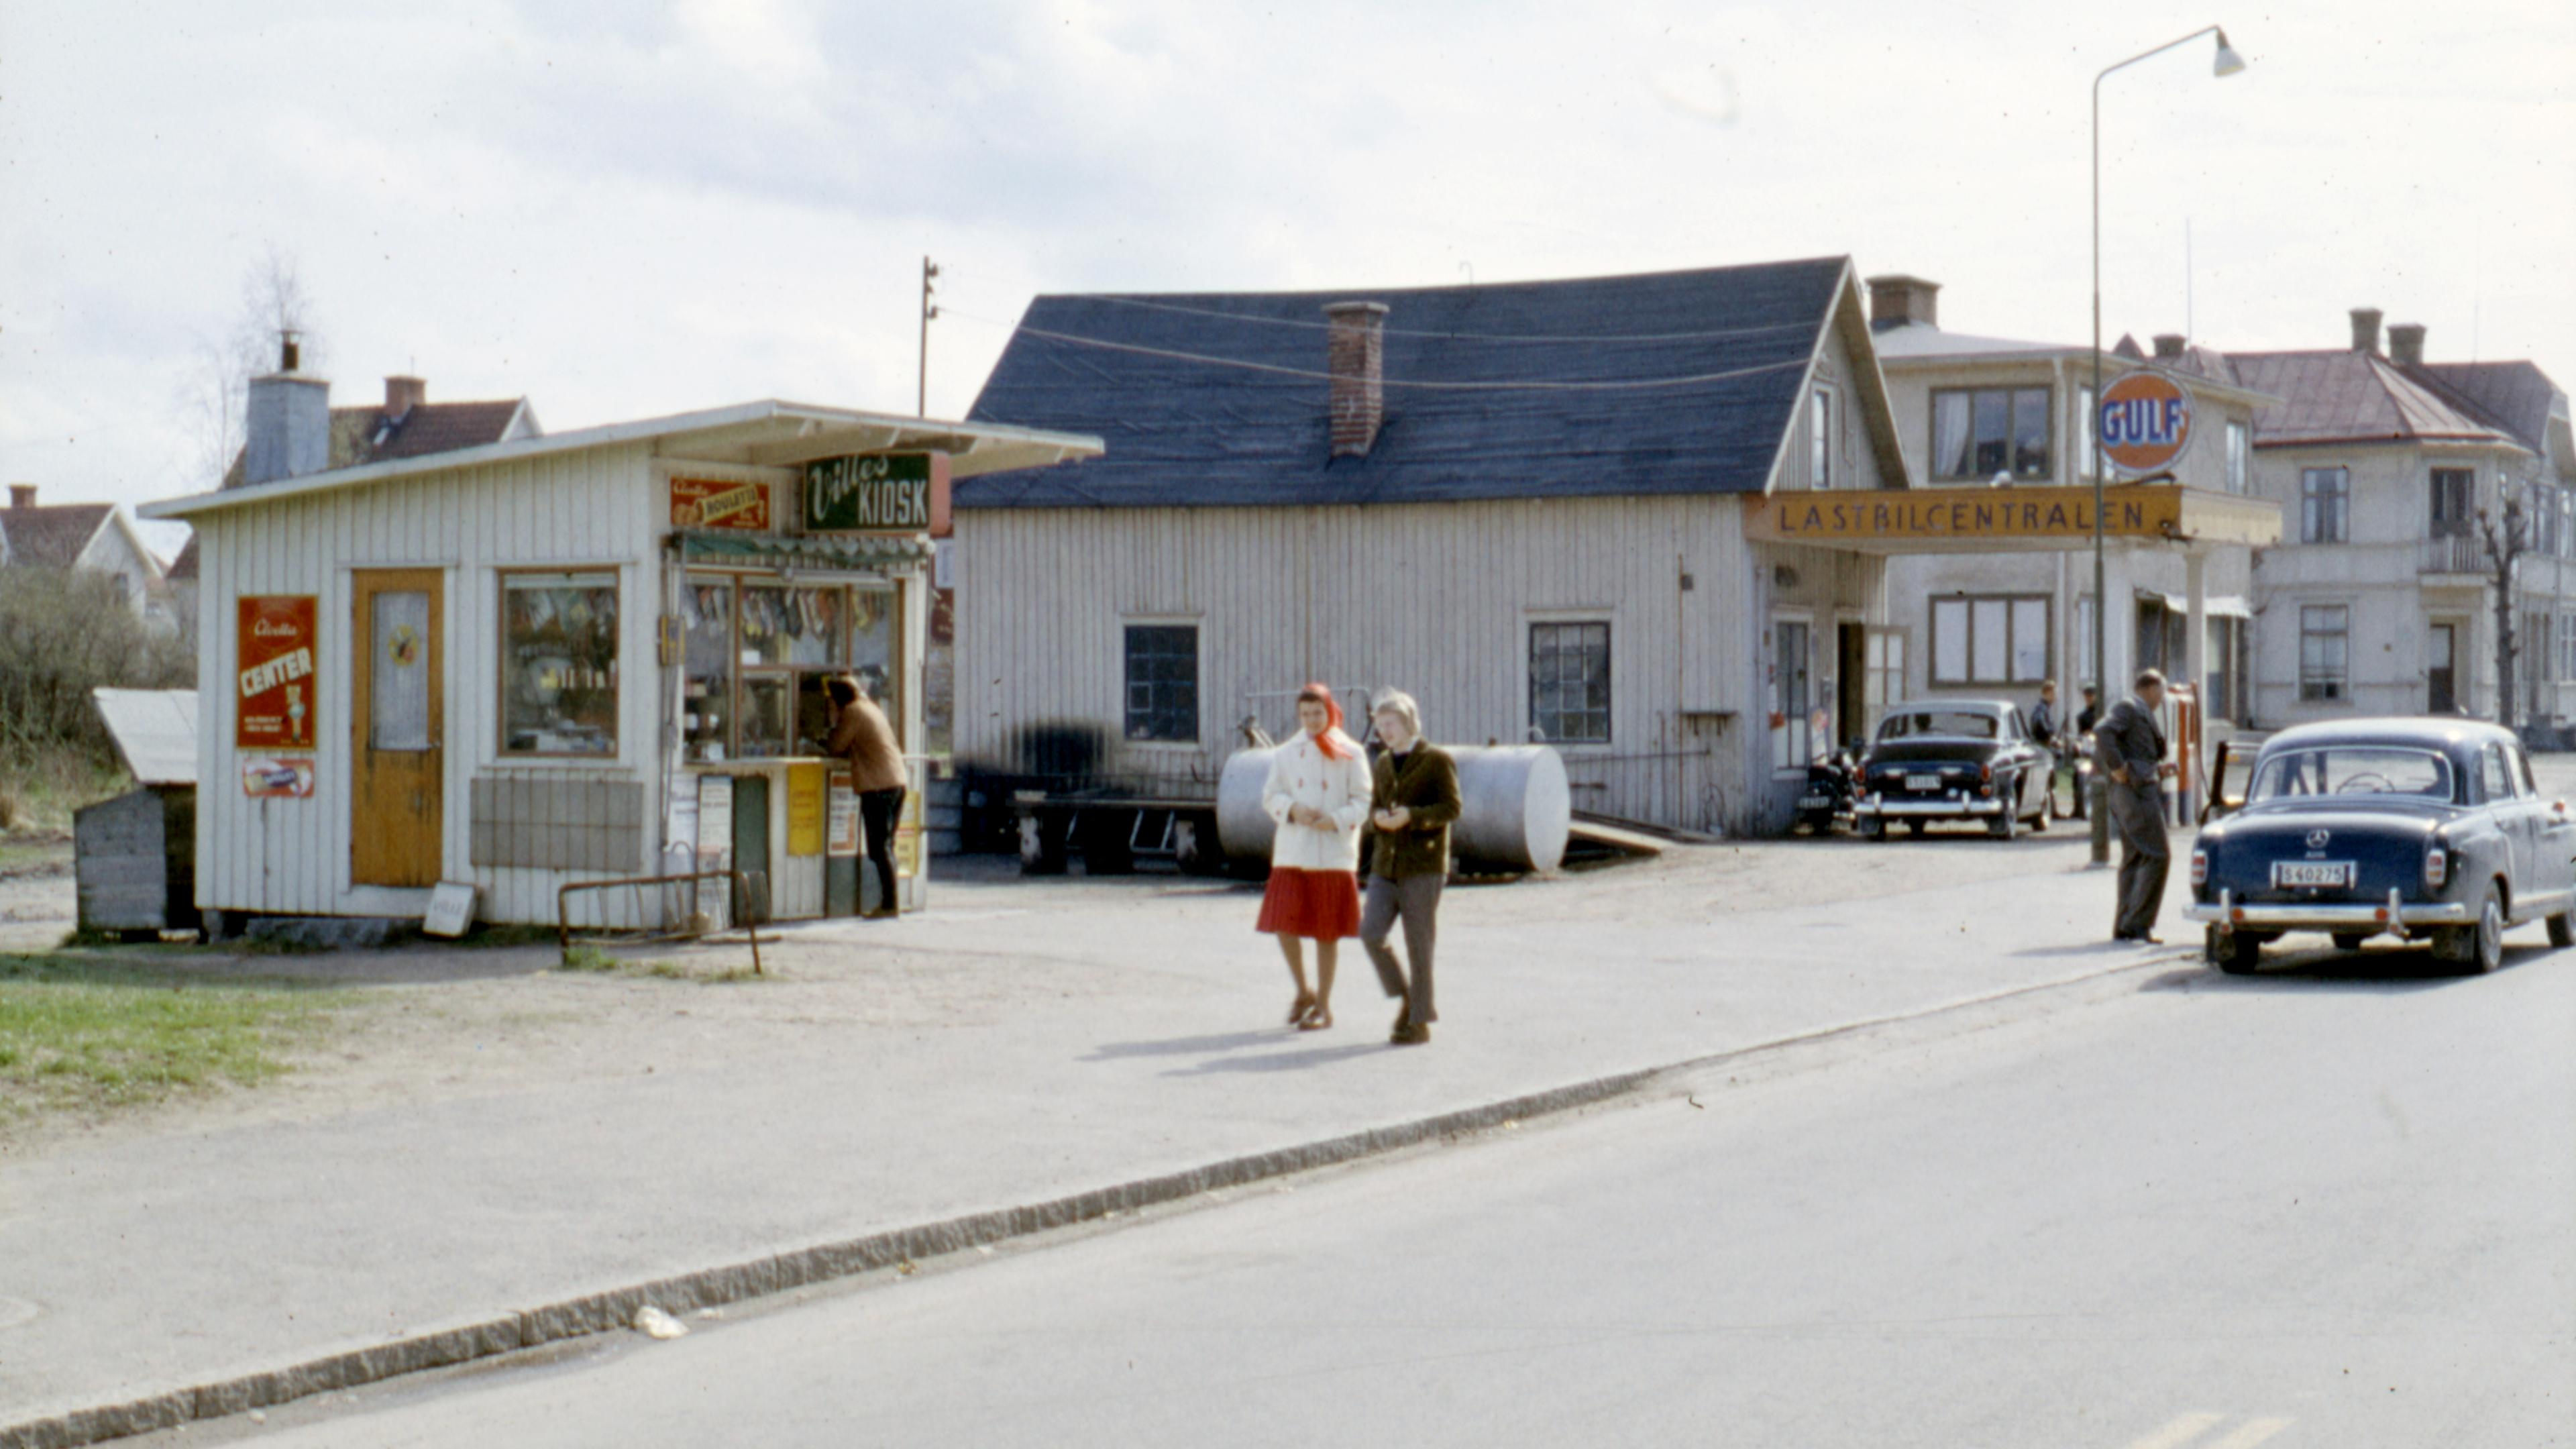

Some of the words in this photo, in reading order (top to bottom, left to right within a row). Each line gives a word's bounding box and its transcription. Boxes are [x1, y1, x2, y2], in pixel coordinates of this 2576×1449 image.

[2102, 397, 2185, 447] GULF
[859, 479, 928, 525] KIOSK
[1780, 502, 2143, 531] LASTBILCENTRALEN
[241, 647, 313, 698] CENTER
